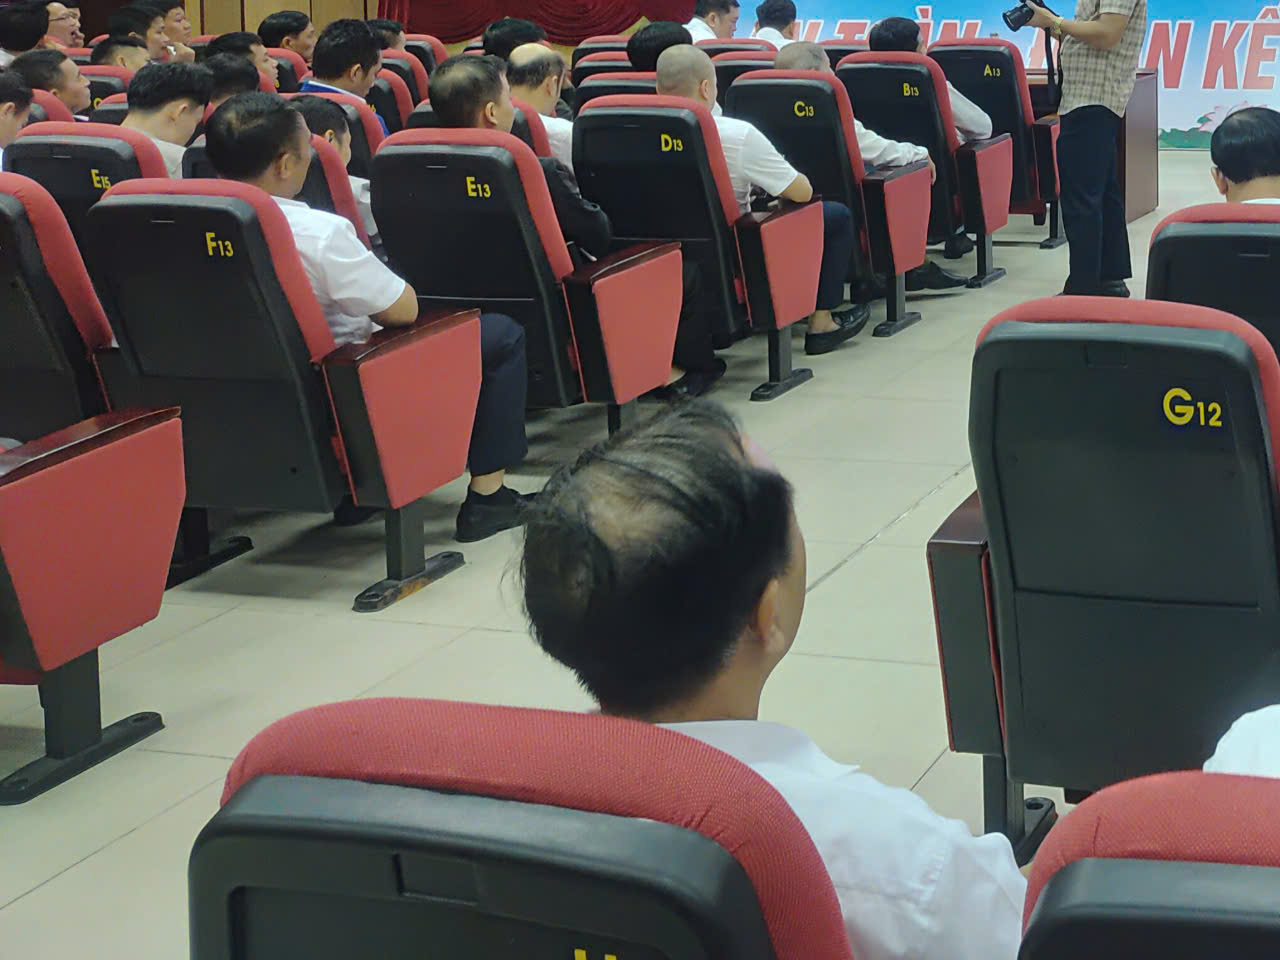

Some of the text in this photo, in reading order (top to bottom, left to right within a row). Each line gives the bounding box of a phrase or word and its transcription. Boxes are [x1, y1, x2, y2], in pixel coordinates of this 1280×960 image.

[984, 64, 1000, 78] A13
[903, 82, 920, 97] B13
[793, 100, 815, 119] C13
[661, 133, 684, 153] D13
[466, 176, 492, 199] E13
[206, 232, 234, 258] F13
[1163, 387, 1223, 427] G12
